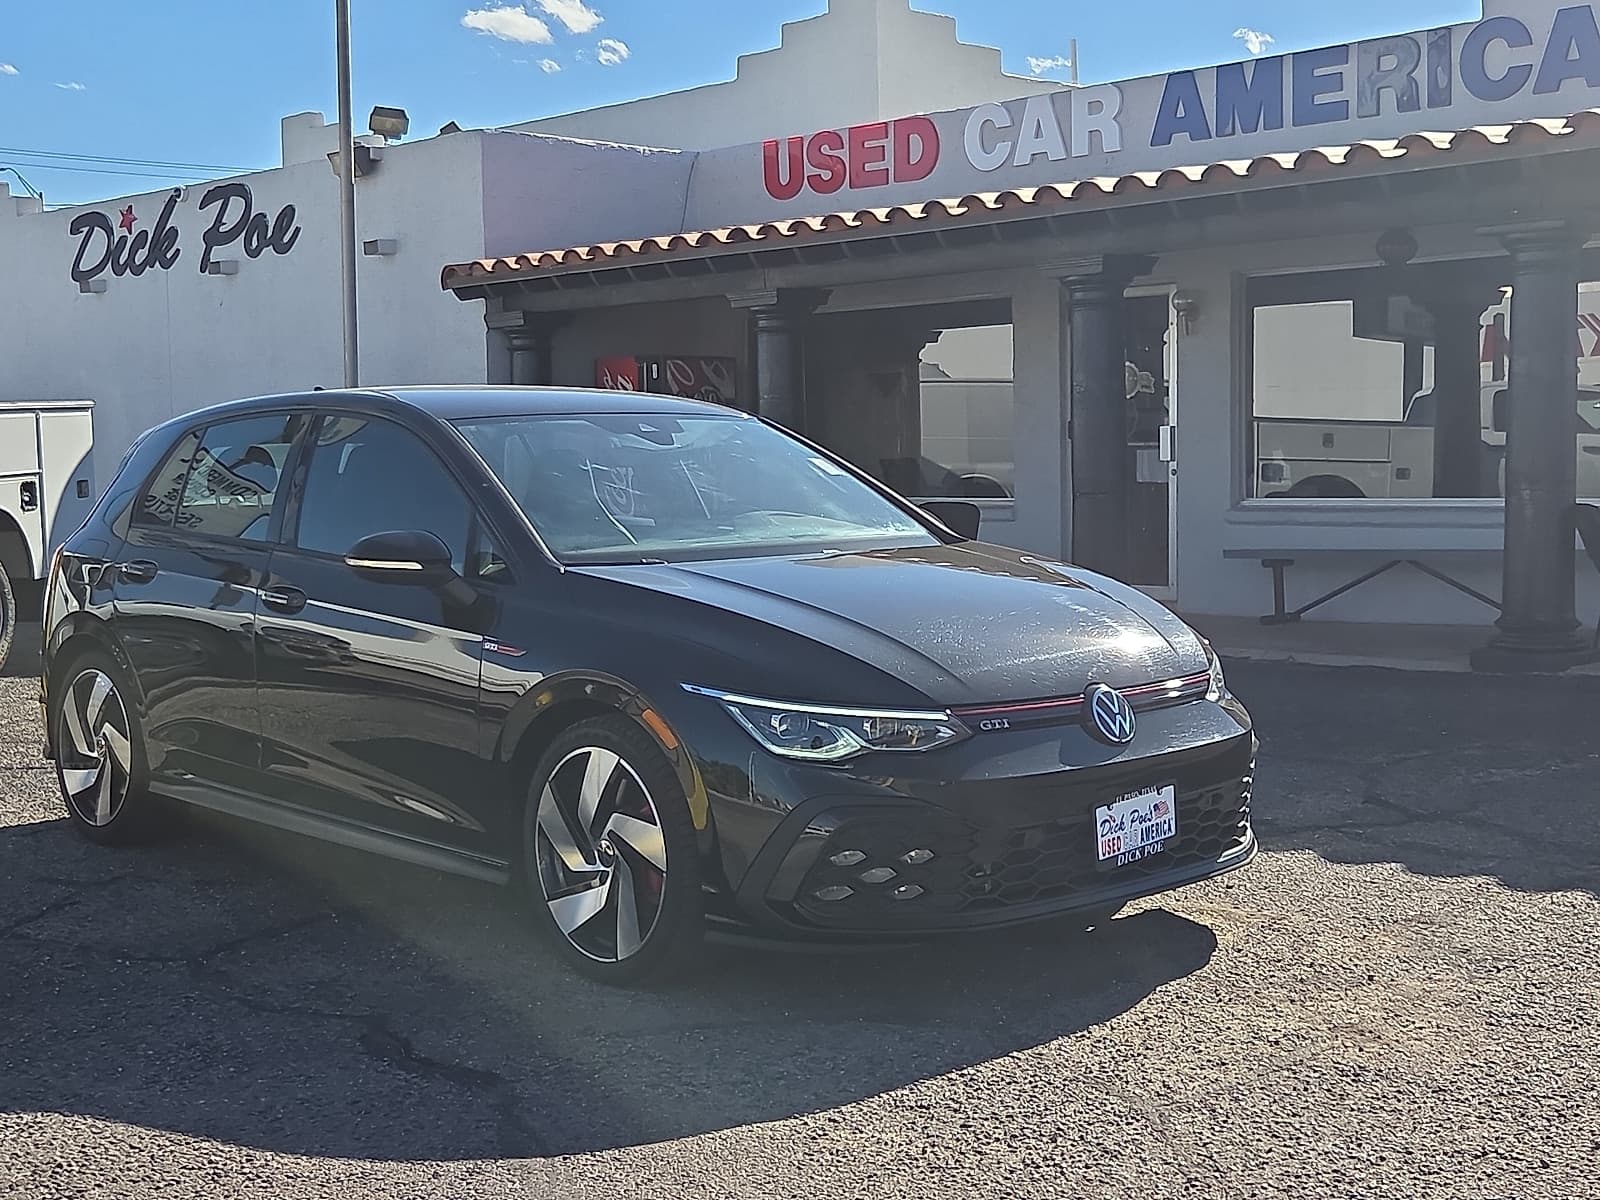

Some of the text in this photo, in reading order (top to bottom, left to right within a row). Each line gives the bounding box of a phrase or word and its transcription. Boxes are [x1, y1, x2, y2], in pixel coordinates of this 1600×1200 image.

[762, 4, 1600, 200] USED CAR AMERICA
[69, 183, 302, 283] Dick Poe
[980, 718, 1011, 732] GTI
[1100, 813, 1127, 838] Dick
[1101, 835, 1122, 857] USED
[1140, 818, 1173, 845] AMERICA
[1117, 841, 1164, 867] DICK POE
